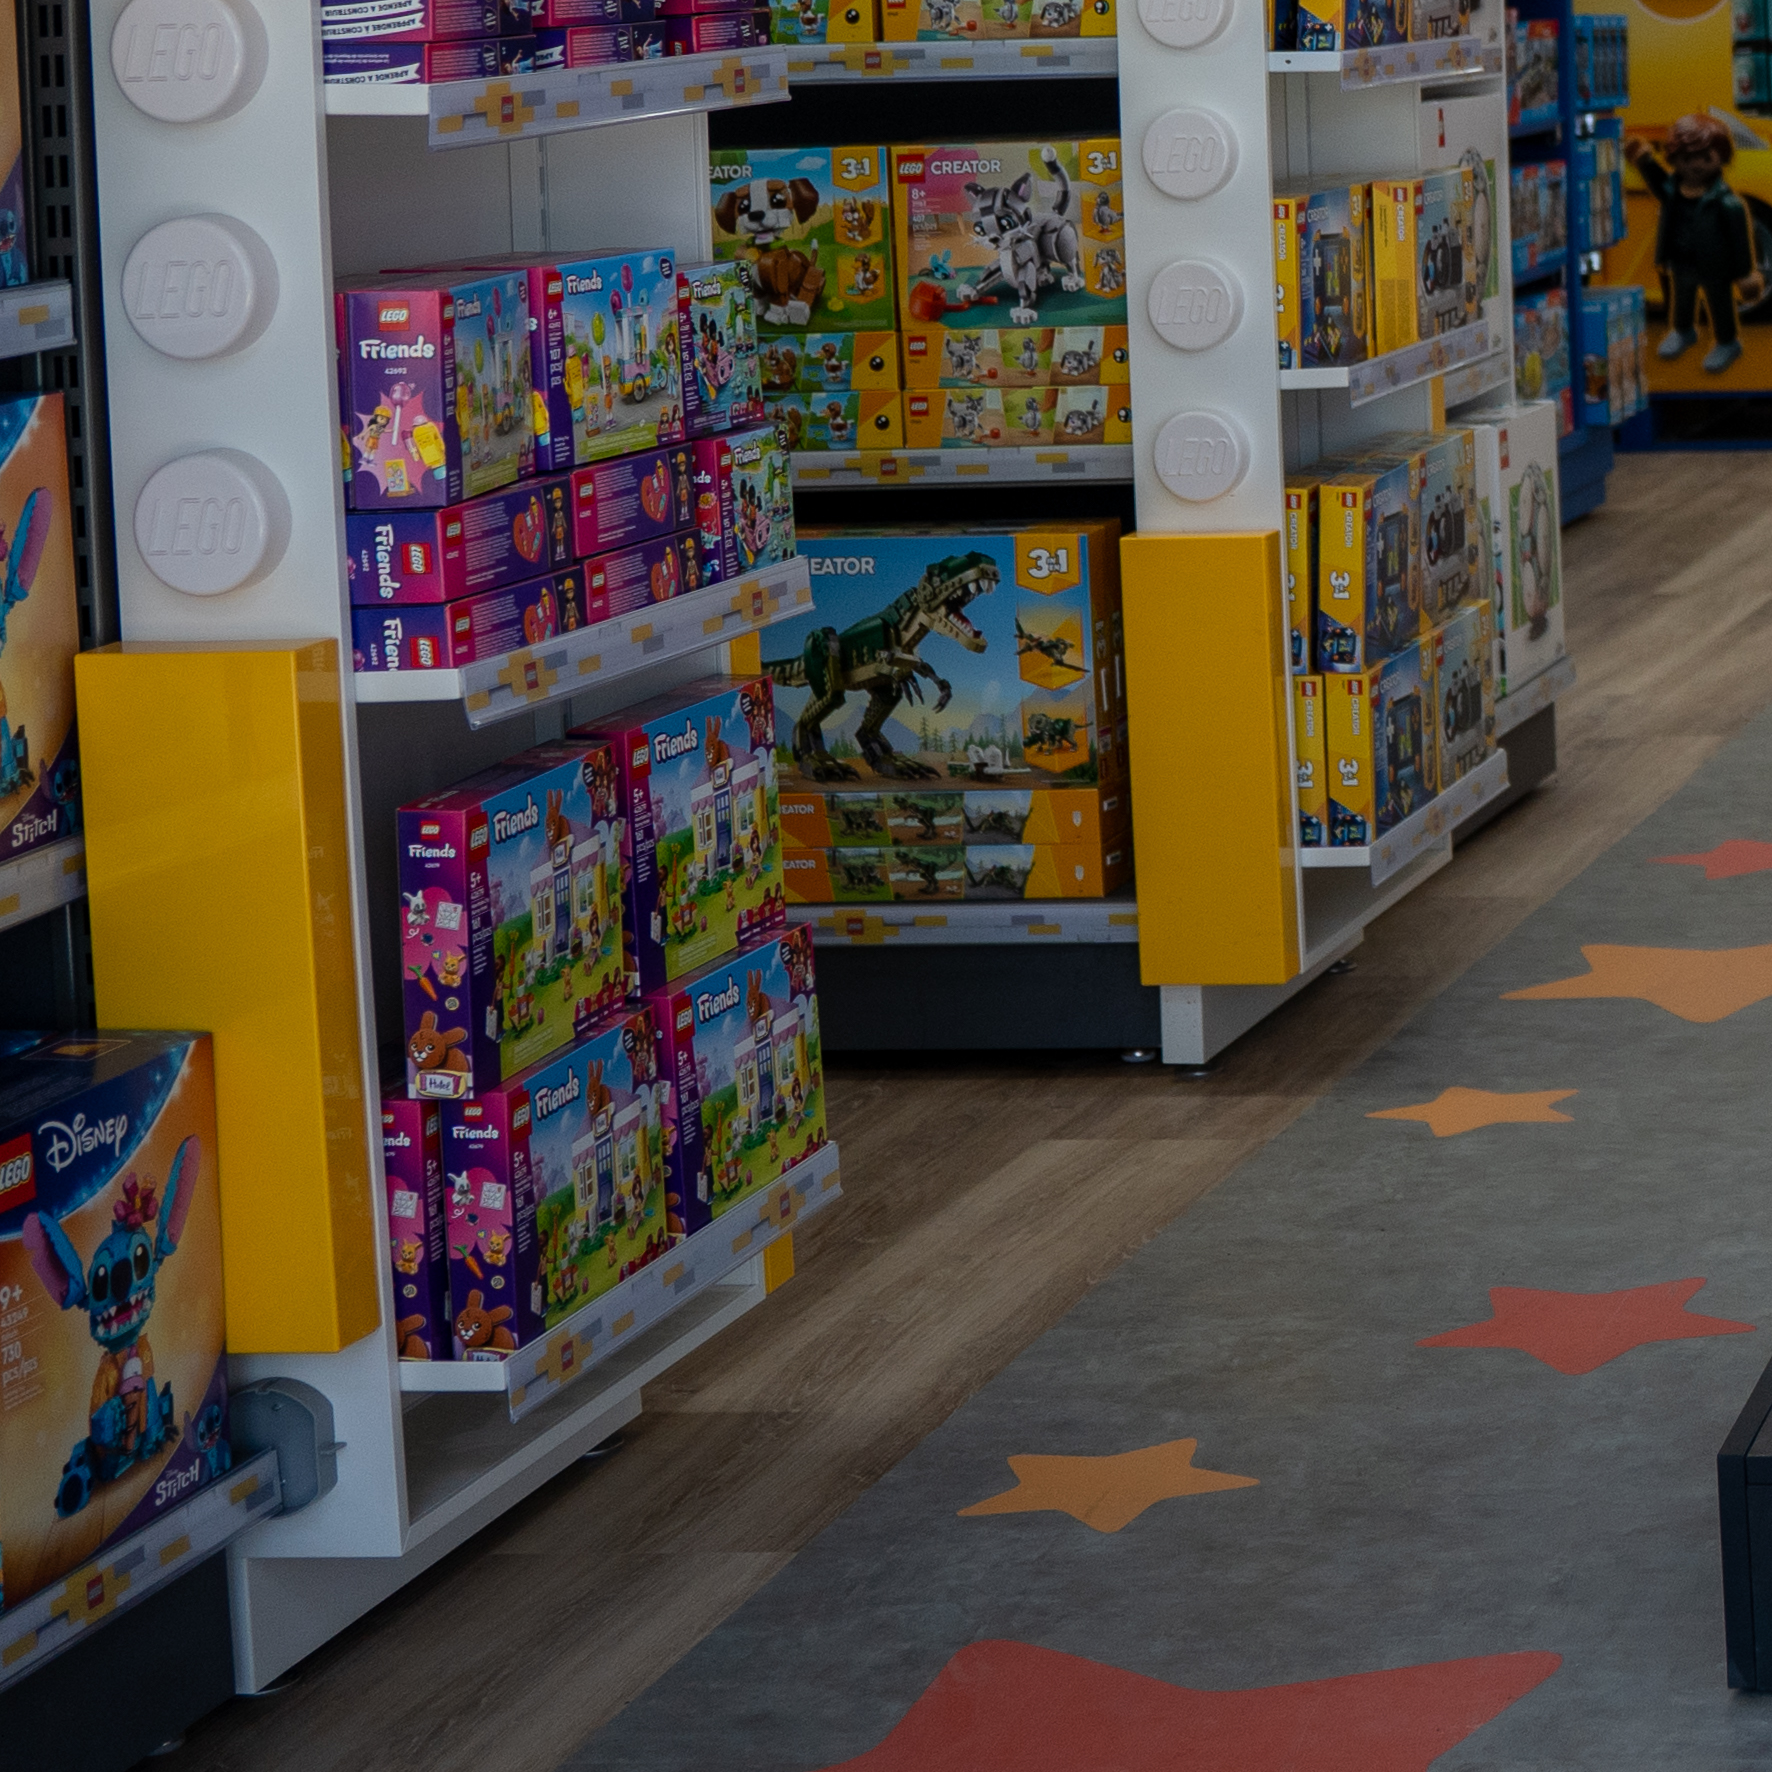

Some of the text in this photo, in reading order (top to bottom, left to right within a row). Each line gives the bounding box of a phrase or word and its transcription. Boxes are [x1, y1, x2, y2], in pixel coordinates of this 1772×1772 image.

[123, 22, 224, 83] LEGO
[899, 159, 1001, 175] LEGO CREATOR
[1151, 135, 1218, 175] LEGO
[134, 258, 234, 320] LEGO
[566, 268, 603, 295] Friends
[692, 274, 722, 300] Friends
[379, 308, 409, 323] LEGO
[1157, 284, 1224, 326] LEGO
[358, 334, 436, 360] Friends
[733, 439, 762, 467] Friends
[1163, 437, 1229, 477] LEGO
[147, 495, 248, 556] LEGO
[374, 523, 401, 600] Friends
[408, 543, 426, 574] LEGO
[417, 636, 434, 668] LEGO
[632, 718, 699, 769] LEGO Friends
[469, 792, 540, 852] LEGO Friends
[408, 842, 457, 860] Friends
[675, 975, 741, 1032] LEGO Friends
[512, 1066, 581, 1131] LEGO Friends
[37, 1111, 129, 1174] Disney
[451, 1124, 500, 1141] Friends
